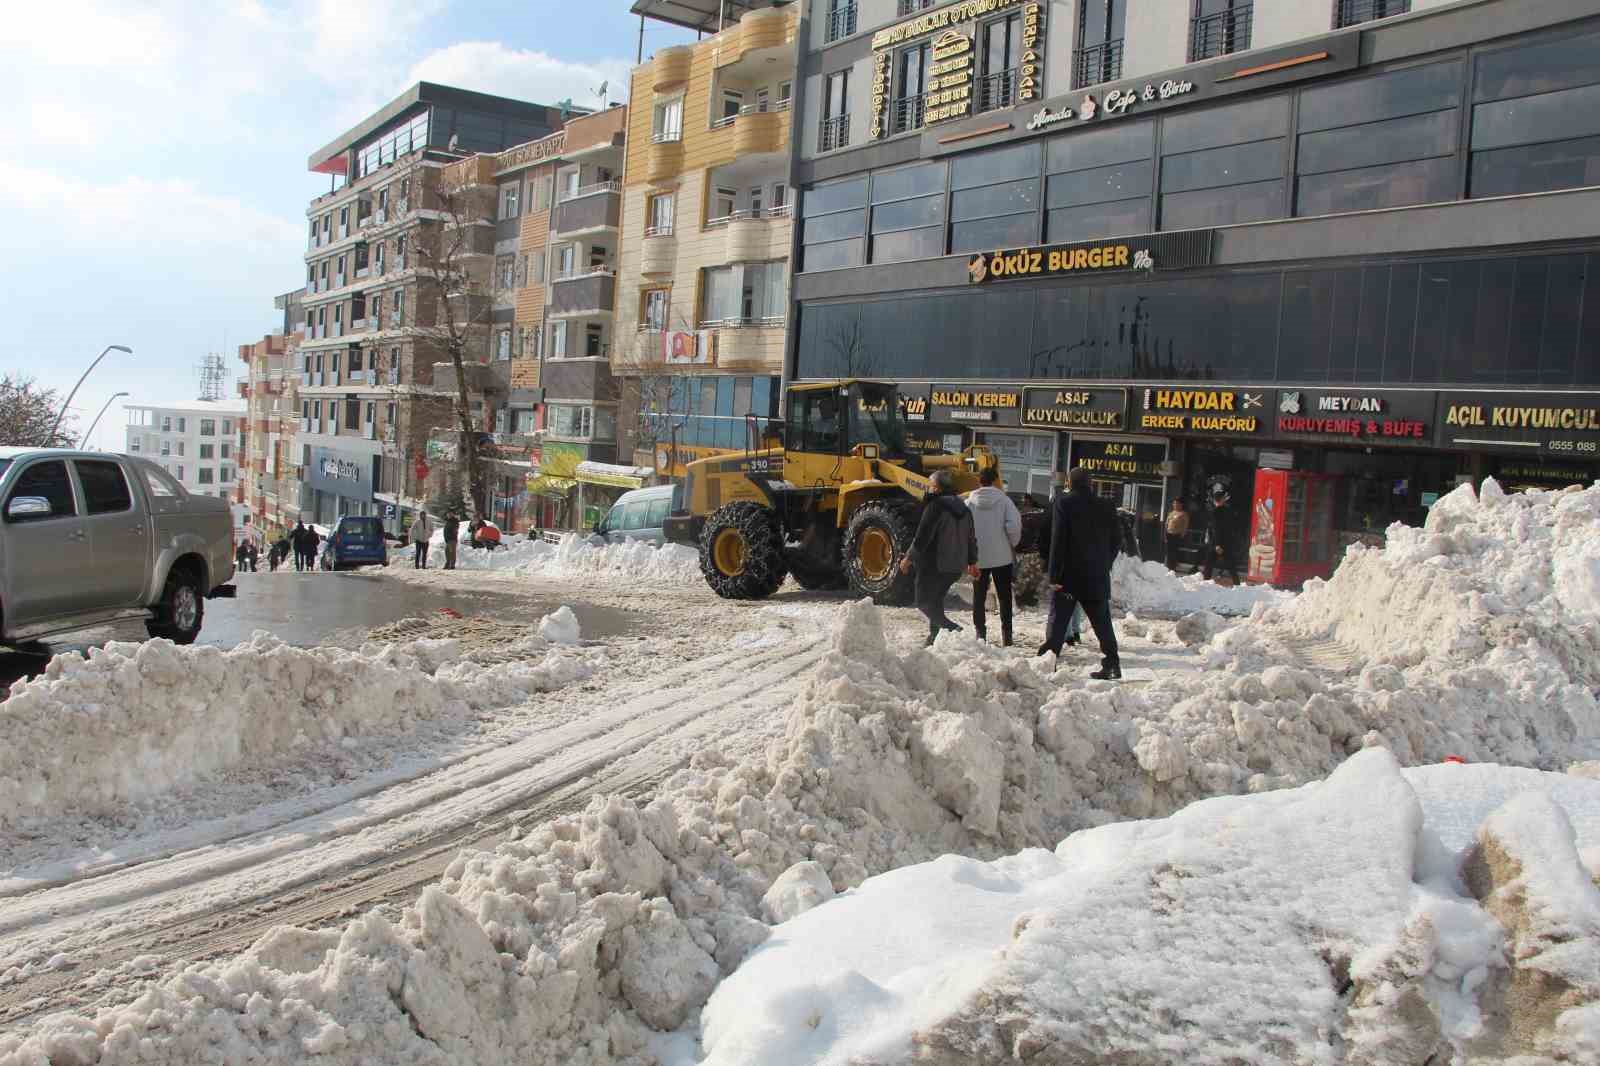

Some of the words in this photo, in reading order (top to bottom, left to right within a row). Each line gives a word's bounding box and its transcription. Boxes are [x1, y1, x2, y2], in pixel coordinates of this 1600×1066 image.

[990, 249, 1042, 276] ÖKÜZ
[1048, 245, 1129, 271] BURGER
[931, 391, 969, 407] SALON
[973, 392, 1016, 408] KEREM
[1055, 391, 1091, 405] ASAF
[1156, 390, 1234, 410] HAYDAR
[1319, 396, 1381, 412] MEYDAN
[1027, 408, 1119, 425] KUYUMCULUK
[1142, 415, 1184, 429] ERKEK
[1191, 414, 1256, 432] KUAFÖRÜ
[1446, 405, 1485, 428] AÇIL
[1366, 420, 1377, 433] &
[1549, 440, 1573, 451] 0555
[1577, 441, 1596, 452] 088
